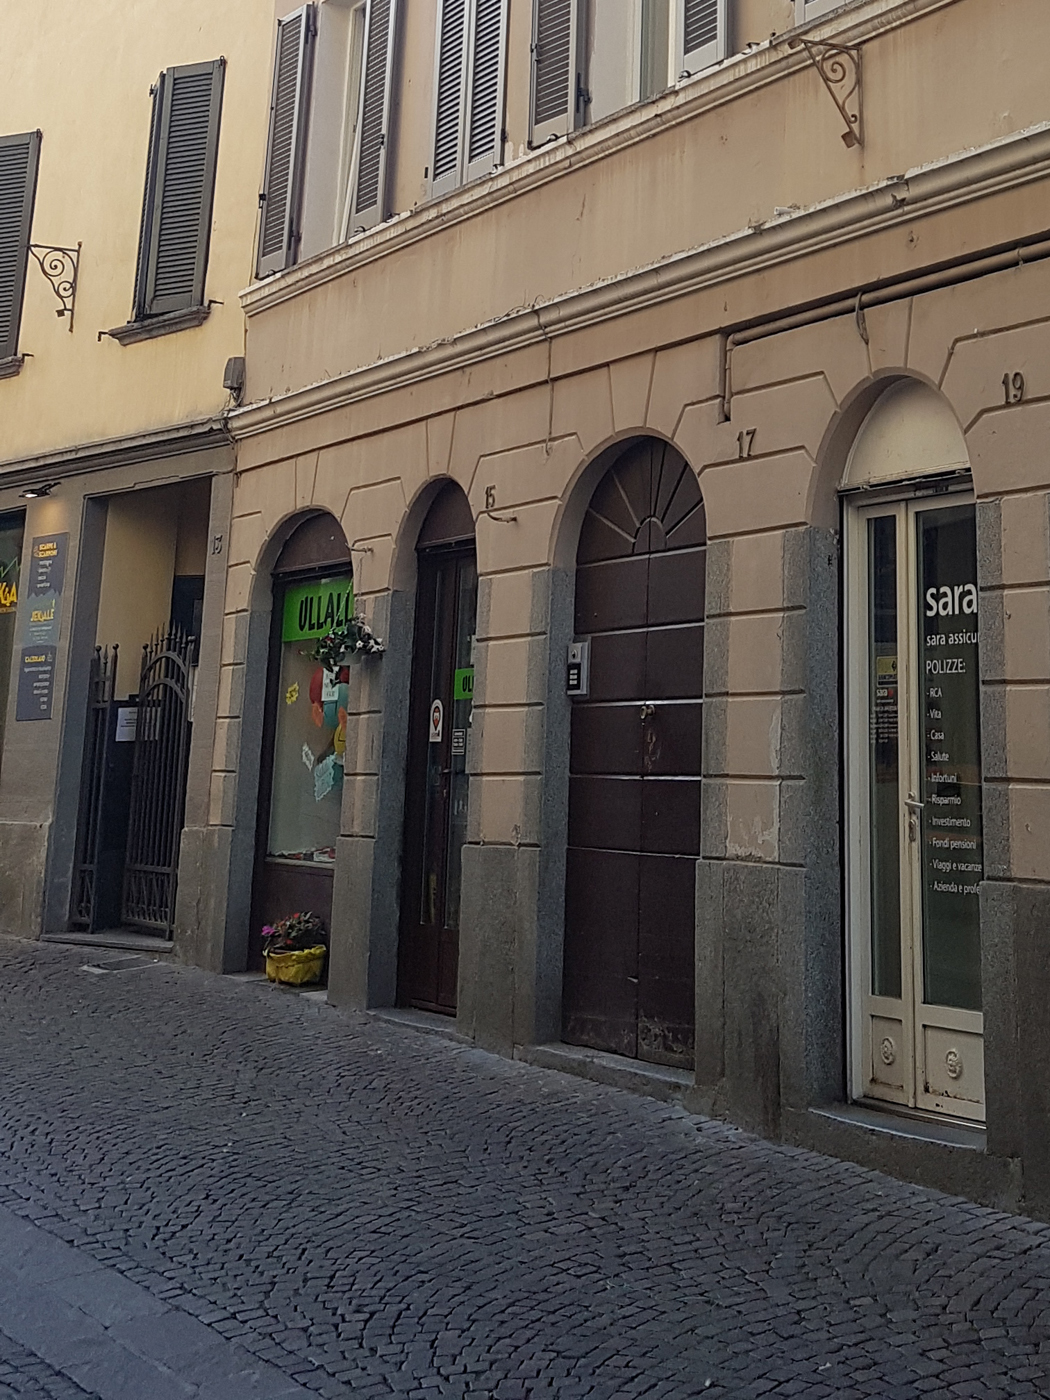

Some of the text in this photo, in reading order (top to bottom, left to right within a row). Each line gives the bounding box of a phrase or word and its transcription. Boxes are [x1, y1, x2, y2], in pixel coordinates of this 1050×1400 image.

[1001, 371, 1025, 404] 19
[736, 428, 757, 458] 17
[485, 485, 496, 509] 15
[925, 583, 978, 617] sara
[926, 634, 946, 647] sara
[926, 658, 966, 675] POLIZZE:
[929, 687, 943, 698] RCA
[929, 708, 942, 719] Vita
[930, 729, 945, 740] Casa
[930, 751, 950, 762] Salute
[931, 772, 958, 783] Infortuni
[931, 793, 962, 807] Risparmio
[932, 815, 971, 827] Investimento
[932, 837, 950, 848] Fondi
[950, 838, 977, 850] pensioni
[932, 858, 952, 873] Viaggi
[933, 880, 958, 893] Azienda
